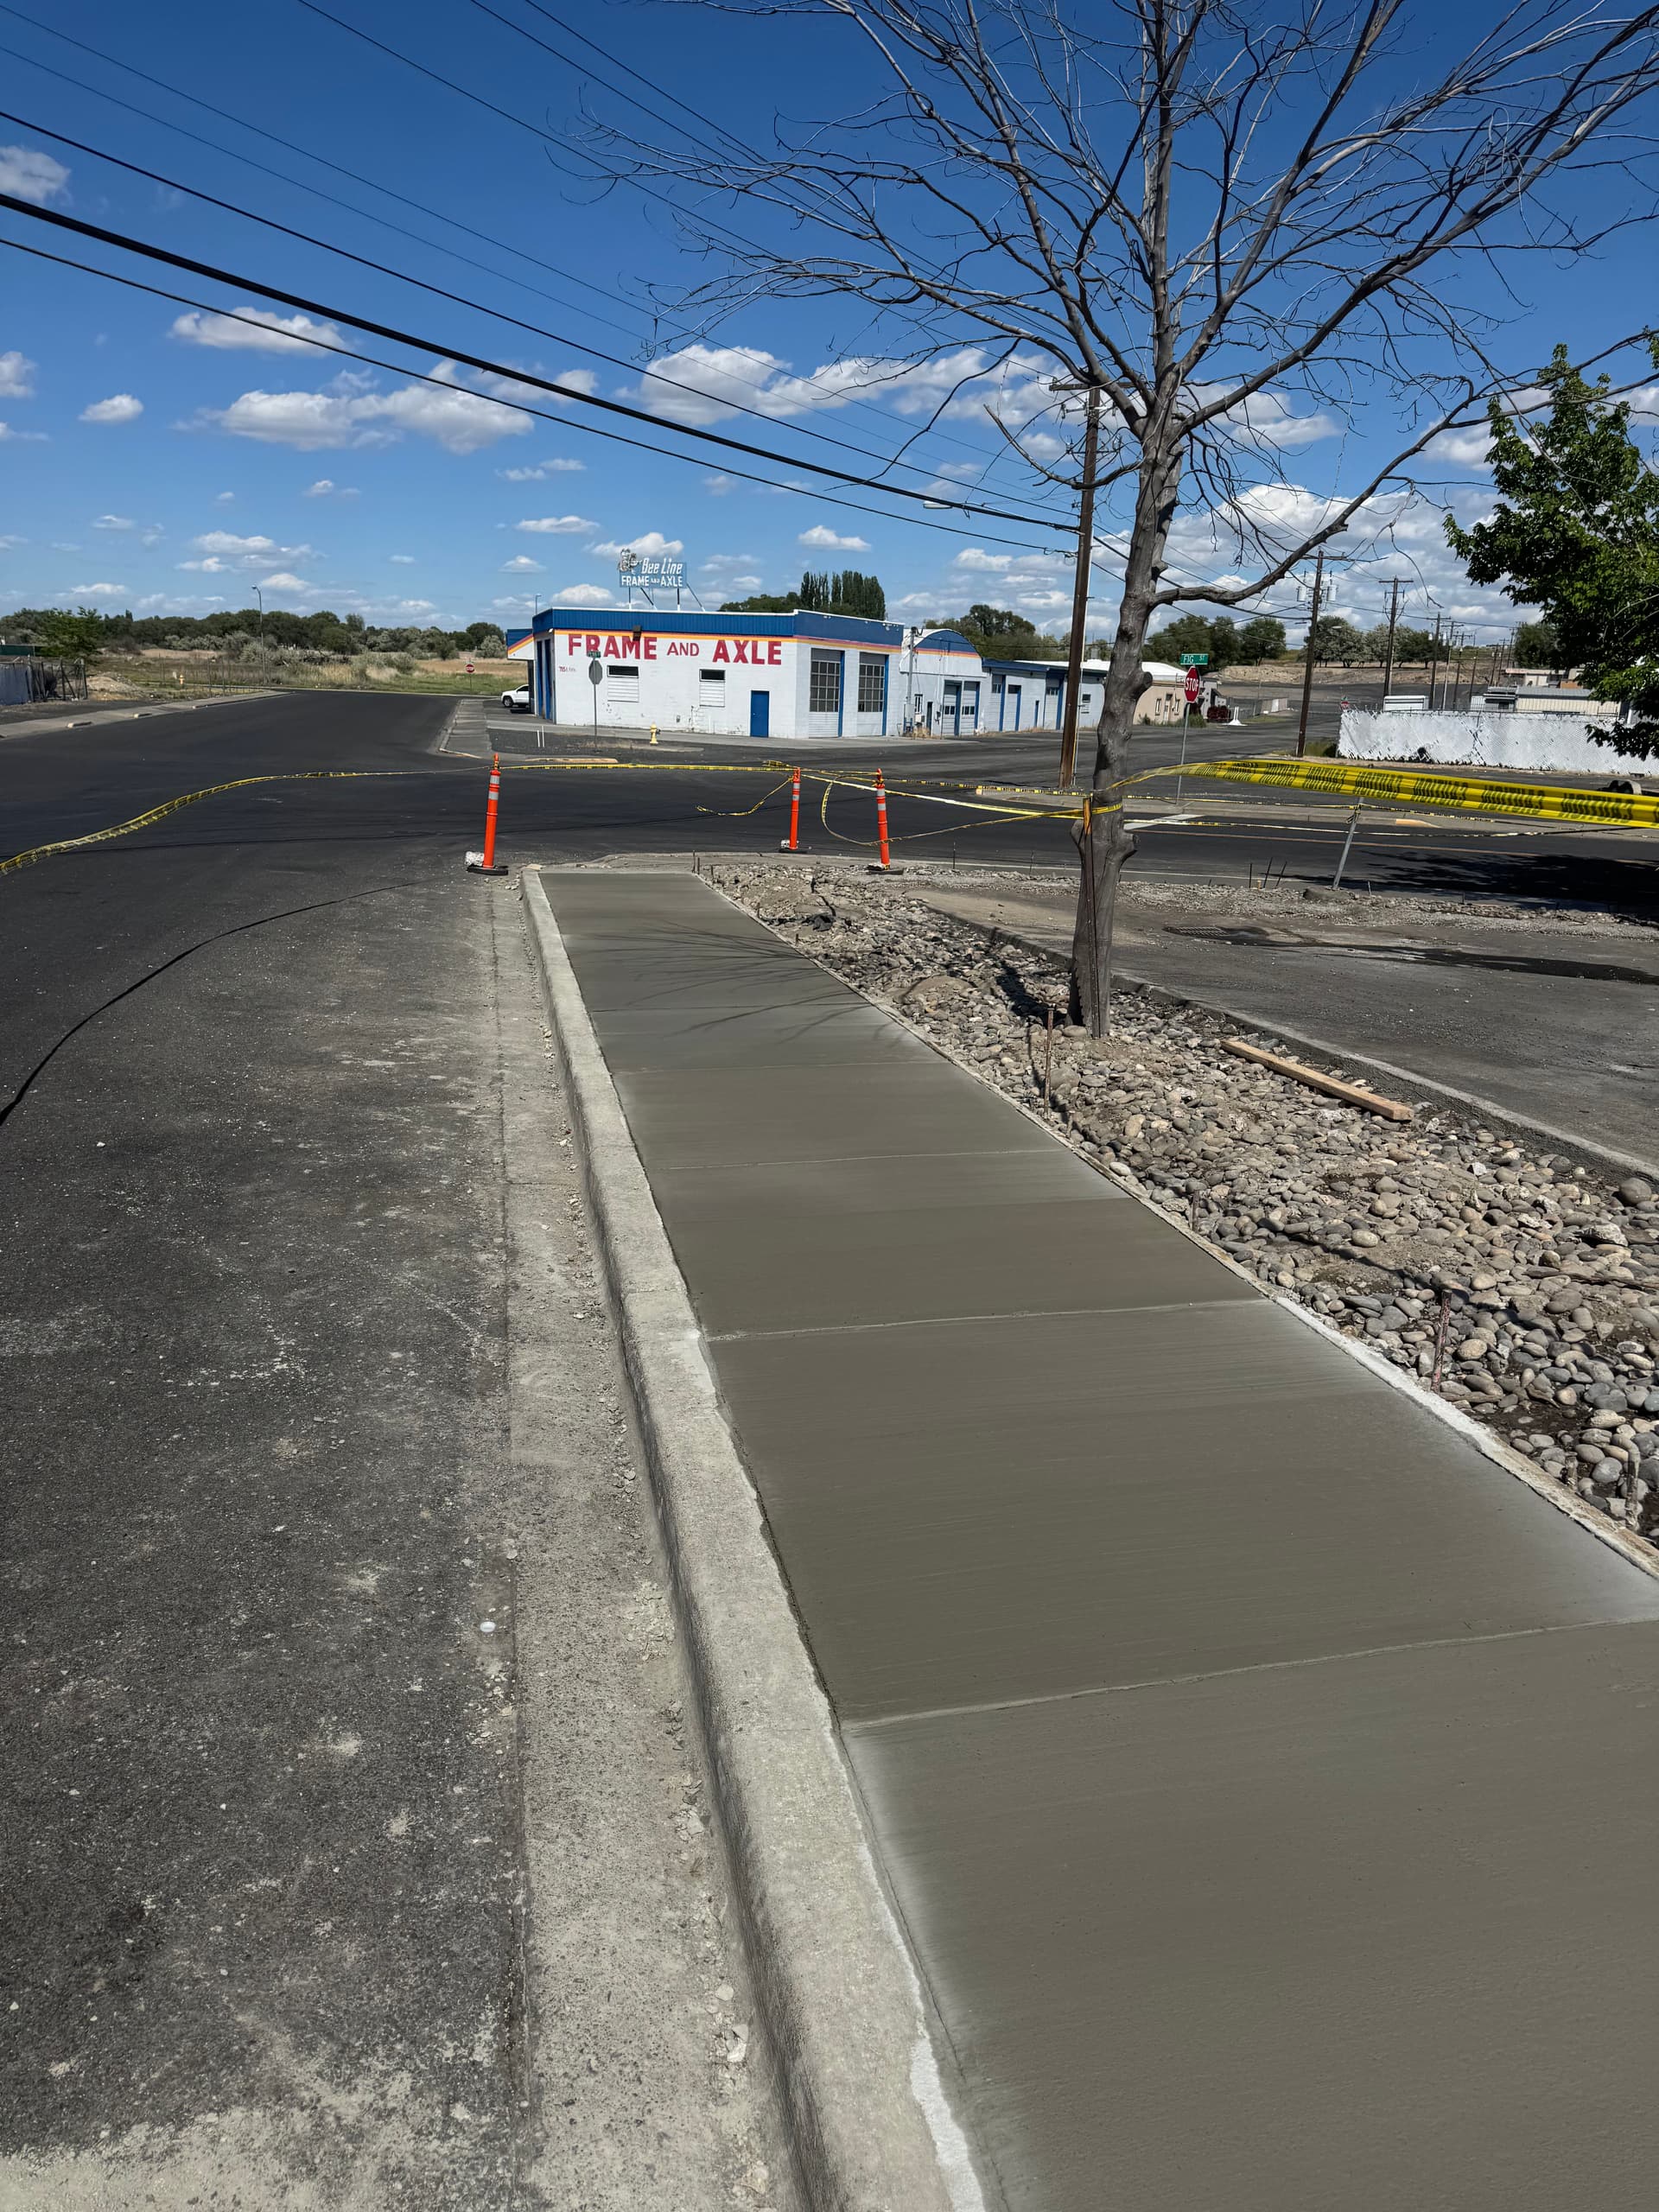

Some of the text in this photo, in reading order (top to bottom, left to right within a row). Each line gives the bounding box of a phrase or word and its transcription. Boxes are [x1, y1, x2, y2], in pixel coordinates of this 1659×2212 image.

[641, 557, 683, 575] Bee Line
[621, 575, 650, 587] FRAME
[660, 575, 683, 587] AXLE
[568, 633, 782, 665] FRAME AND AXLE
[1184, 655, 1194, 664] FIG
[1185, 677, 1198, 691] STOP
